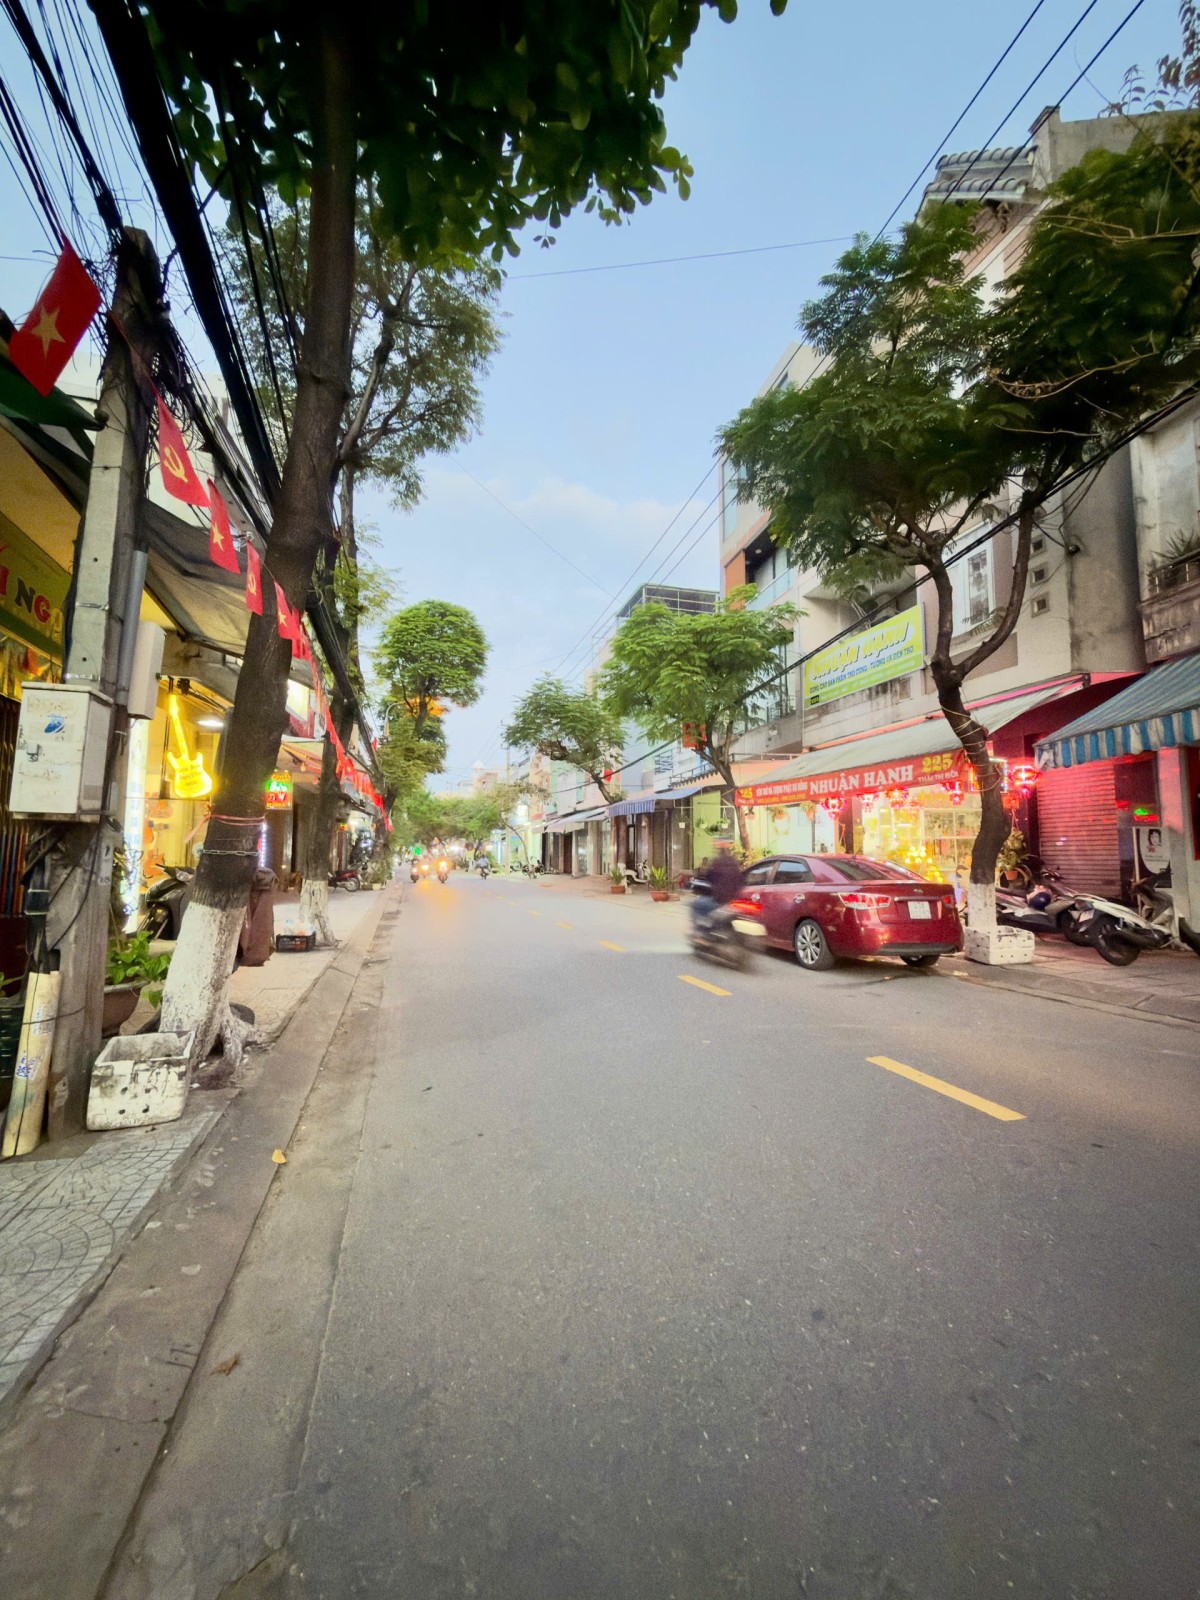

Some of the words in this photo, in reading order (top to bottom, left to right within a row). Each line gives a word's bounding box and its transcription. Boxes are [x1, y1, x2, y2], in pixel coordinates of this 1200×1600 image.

[922, 752, 952, 773] 225
[809, 772, 860, 795] NHUẬN
[864, 764, 914, 790] HẠNH
